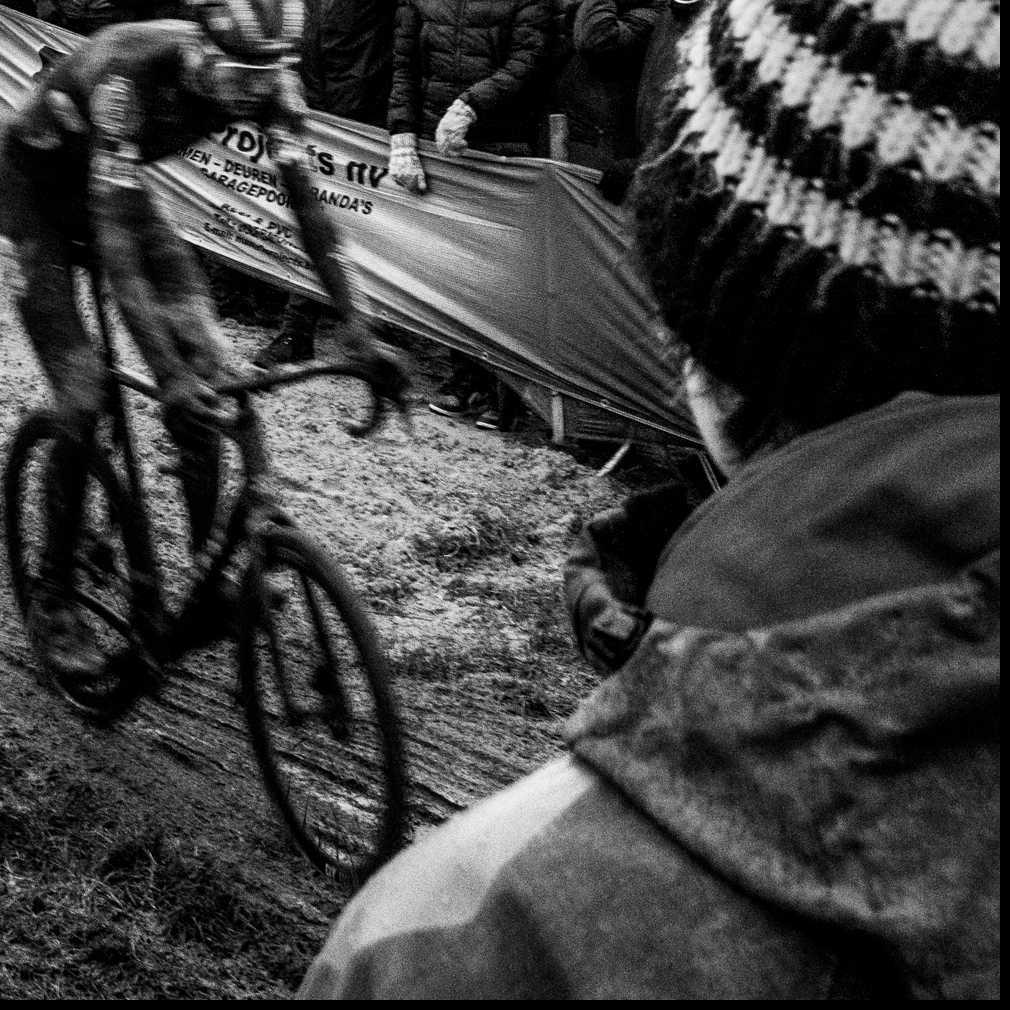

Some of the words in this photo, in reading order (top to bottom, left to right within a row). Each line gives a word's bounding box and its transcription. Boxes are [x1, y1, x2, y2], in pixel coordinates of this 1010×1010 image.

[181, 147, 213, 166] MEN
[223, 158, 278, 188] DEUREN
[310, 185, 374, 215] RANDA'S
[346, 160, 389, 189] nv
